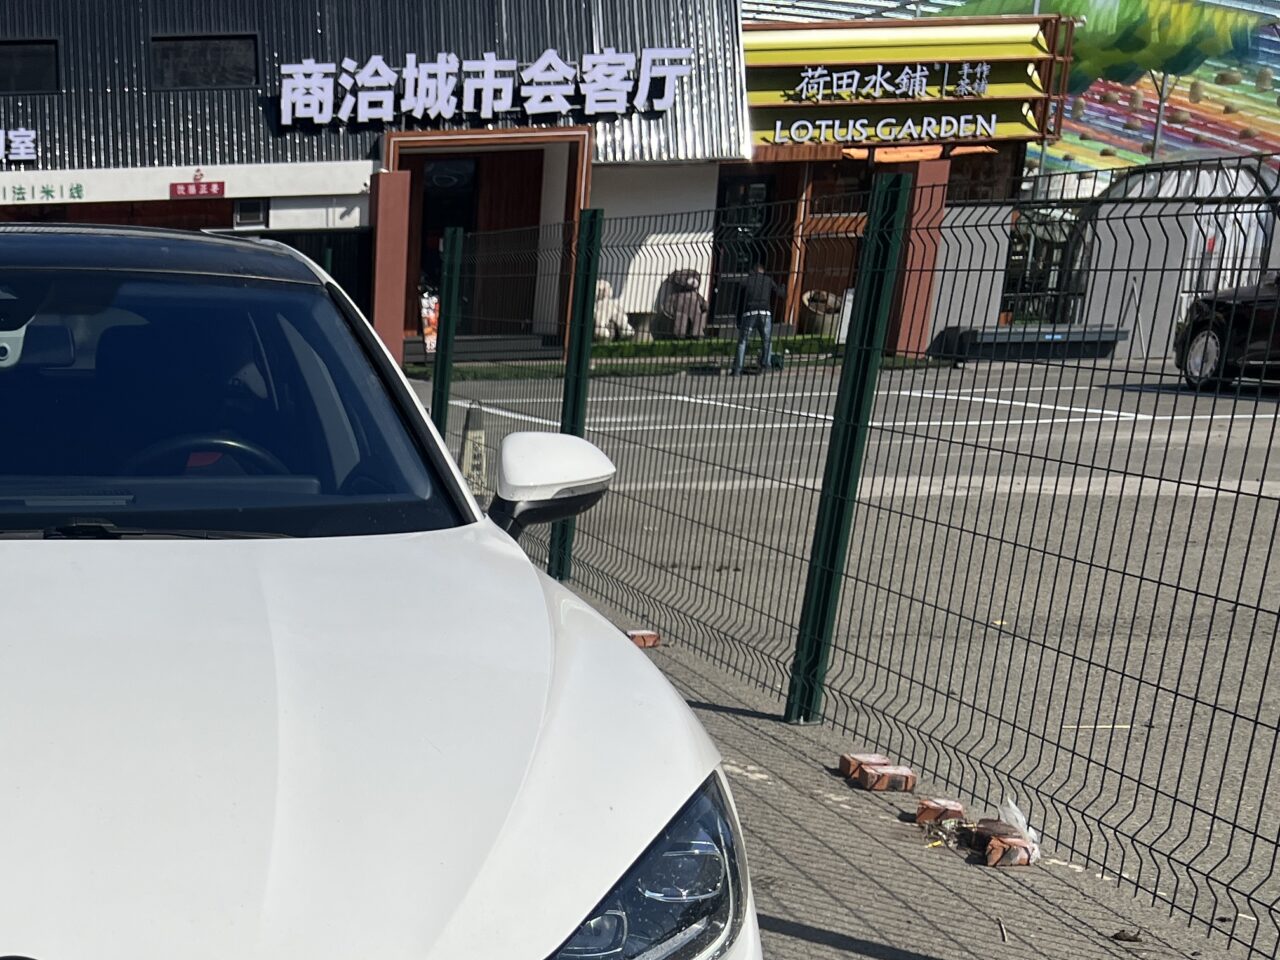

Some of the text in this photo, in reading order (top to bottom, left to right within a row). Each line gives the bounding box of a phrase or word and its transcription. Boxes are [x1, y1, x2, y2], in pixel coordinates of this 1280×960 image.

[280, 47, 693, 125] 商洽城市会客厅
[773, 113, 997, 144] LOTUS GARDEN
